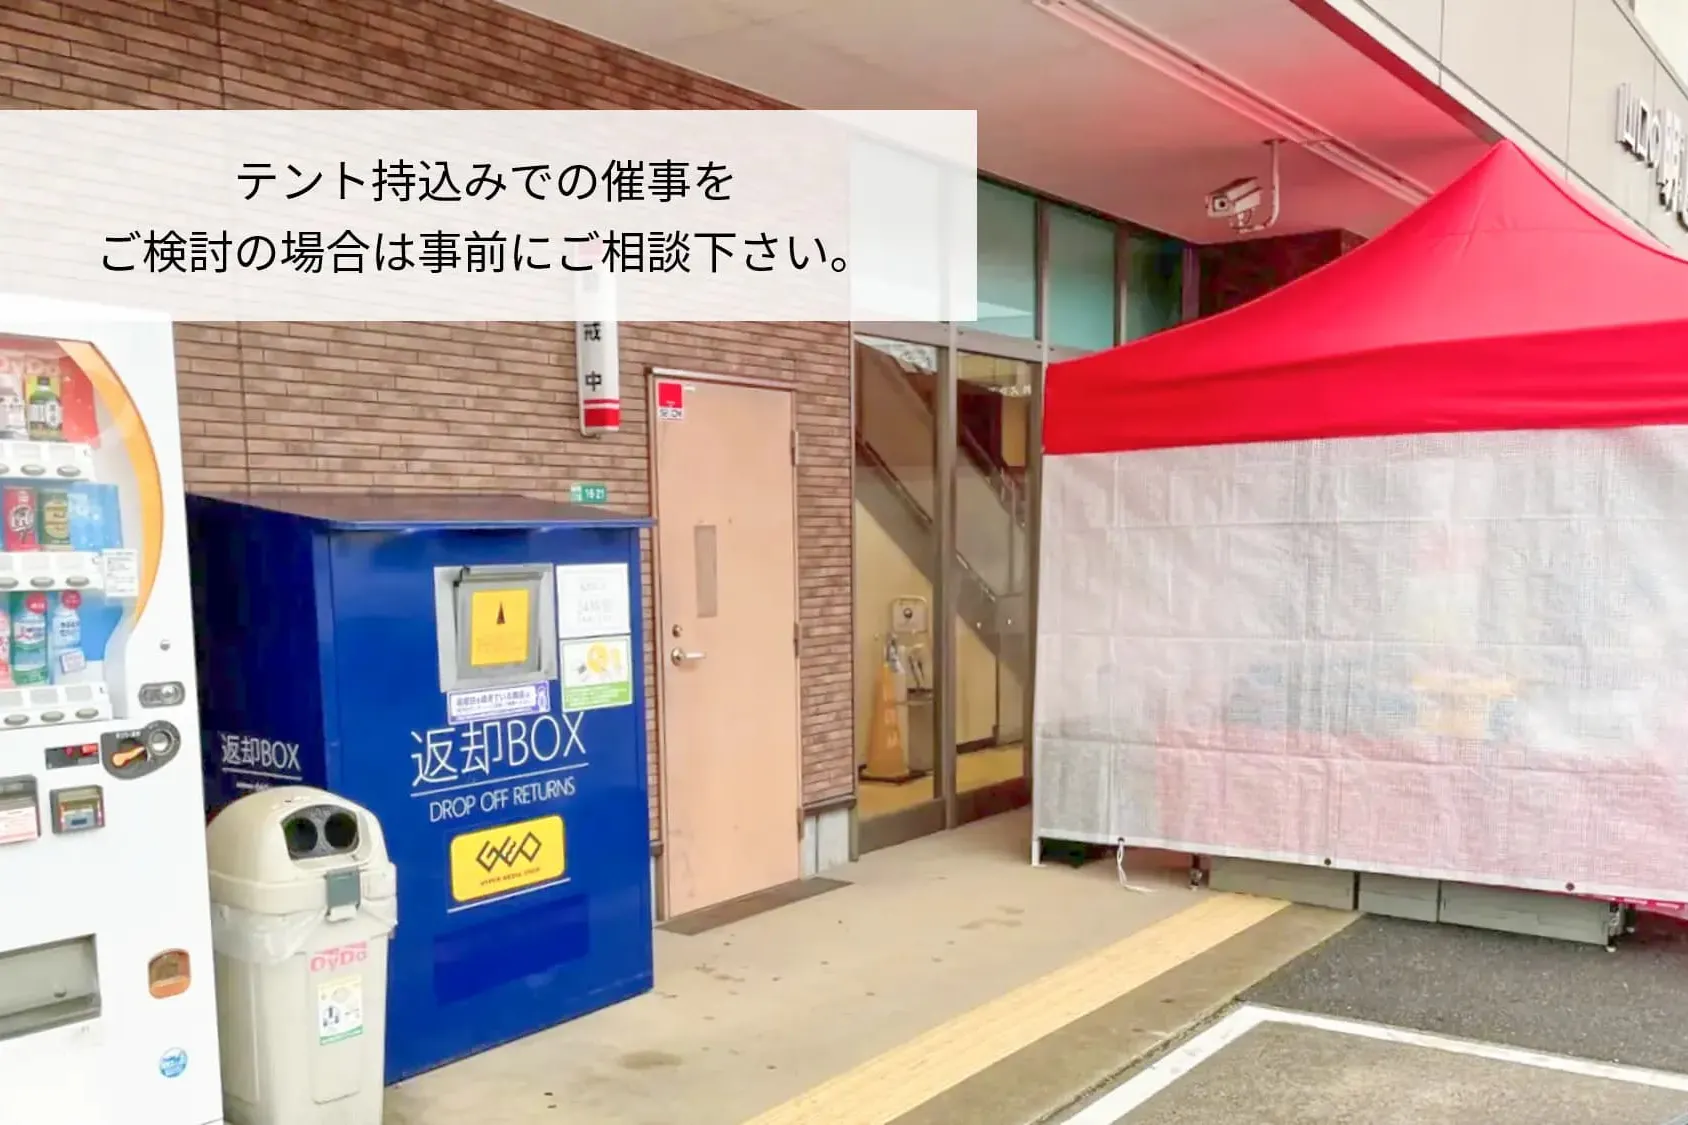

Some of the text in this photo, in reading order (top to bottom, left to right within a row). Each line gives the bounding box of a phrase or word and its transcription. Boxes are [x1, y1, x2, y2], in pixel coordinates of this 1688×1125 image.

[219, 731, 301, 772] 返却BOX
[411, 711, 586, 787] 返却BOX
[429, 776, 576, 822] DROP OFF RETURNS
[476, 831, 542, 873] GEO
[310, 948, 367, 972] DyDo
